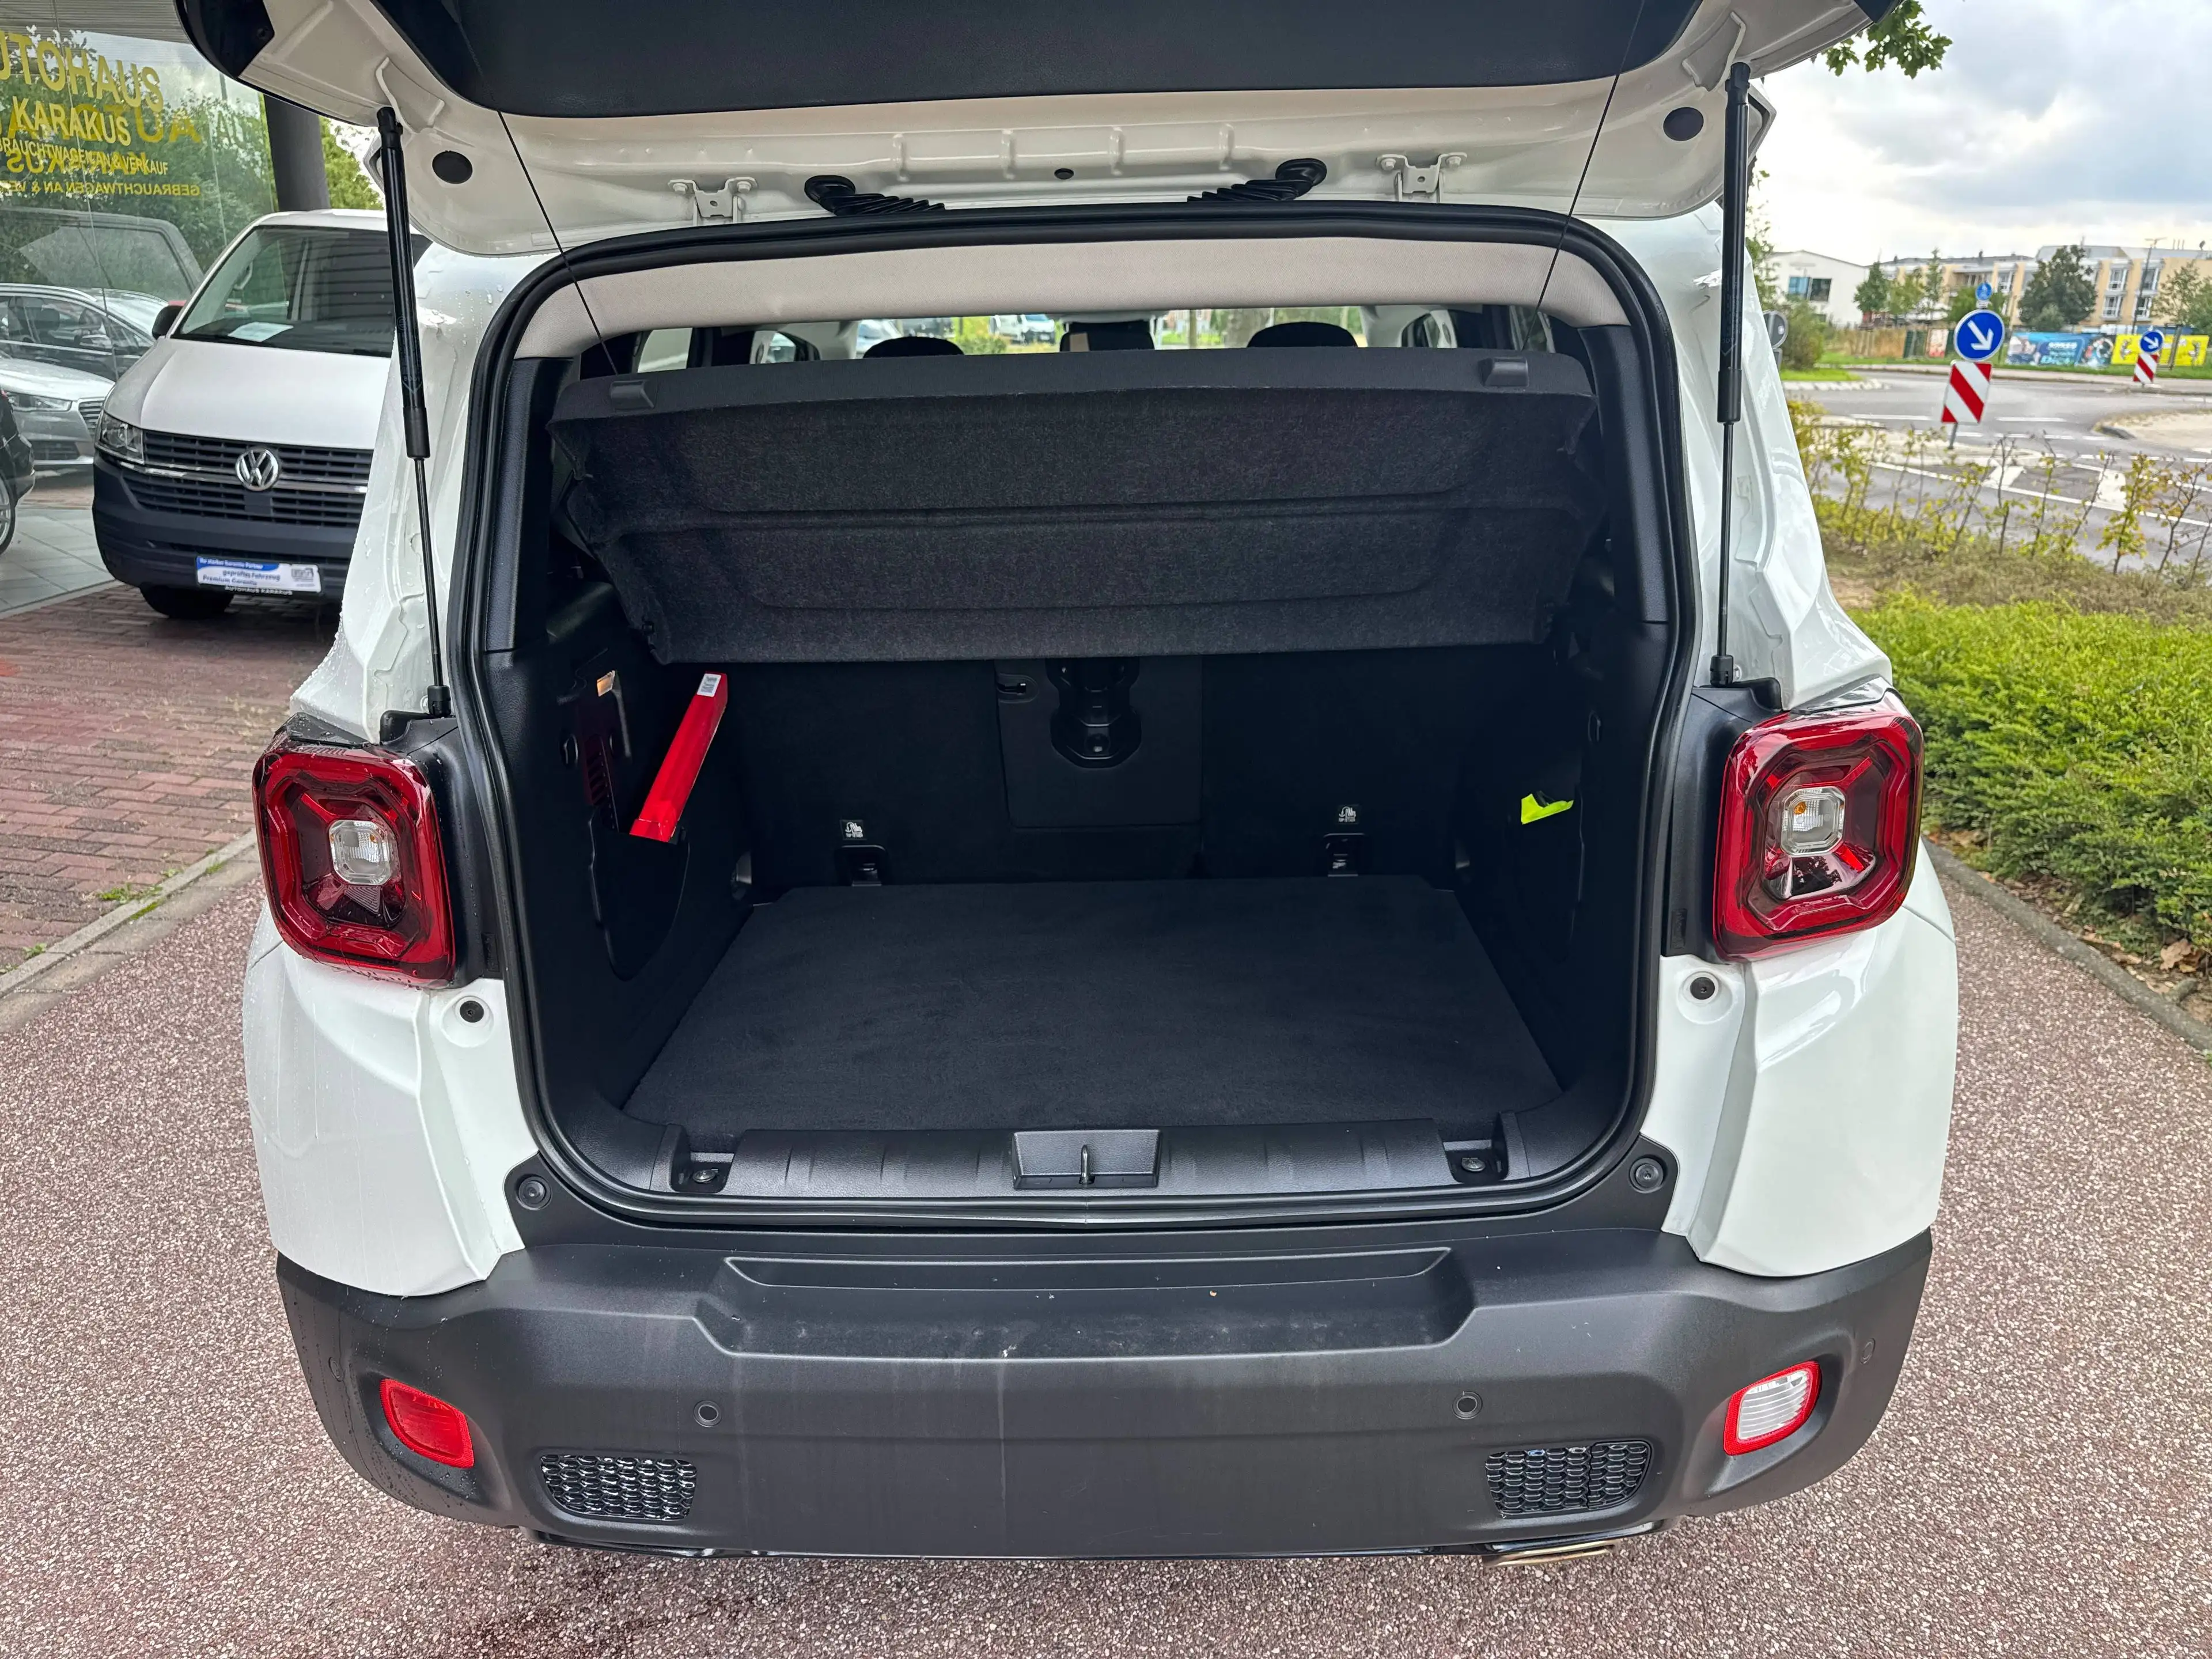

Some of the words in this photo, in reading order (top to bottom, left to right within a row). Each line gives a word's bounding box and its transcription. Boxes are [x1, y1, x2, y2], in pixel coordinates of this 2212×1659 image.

[13, 96, 131, 146] KARAKUS
[0, 137, 94, 166] RAUCHTWAGEN
[122, 155, 169, 175] VERKAUF
[203, 574, 230, 583] Premium
